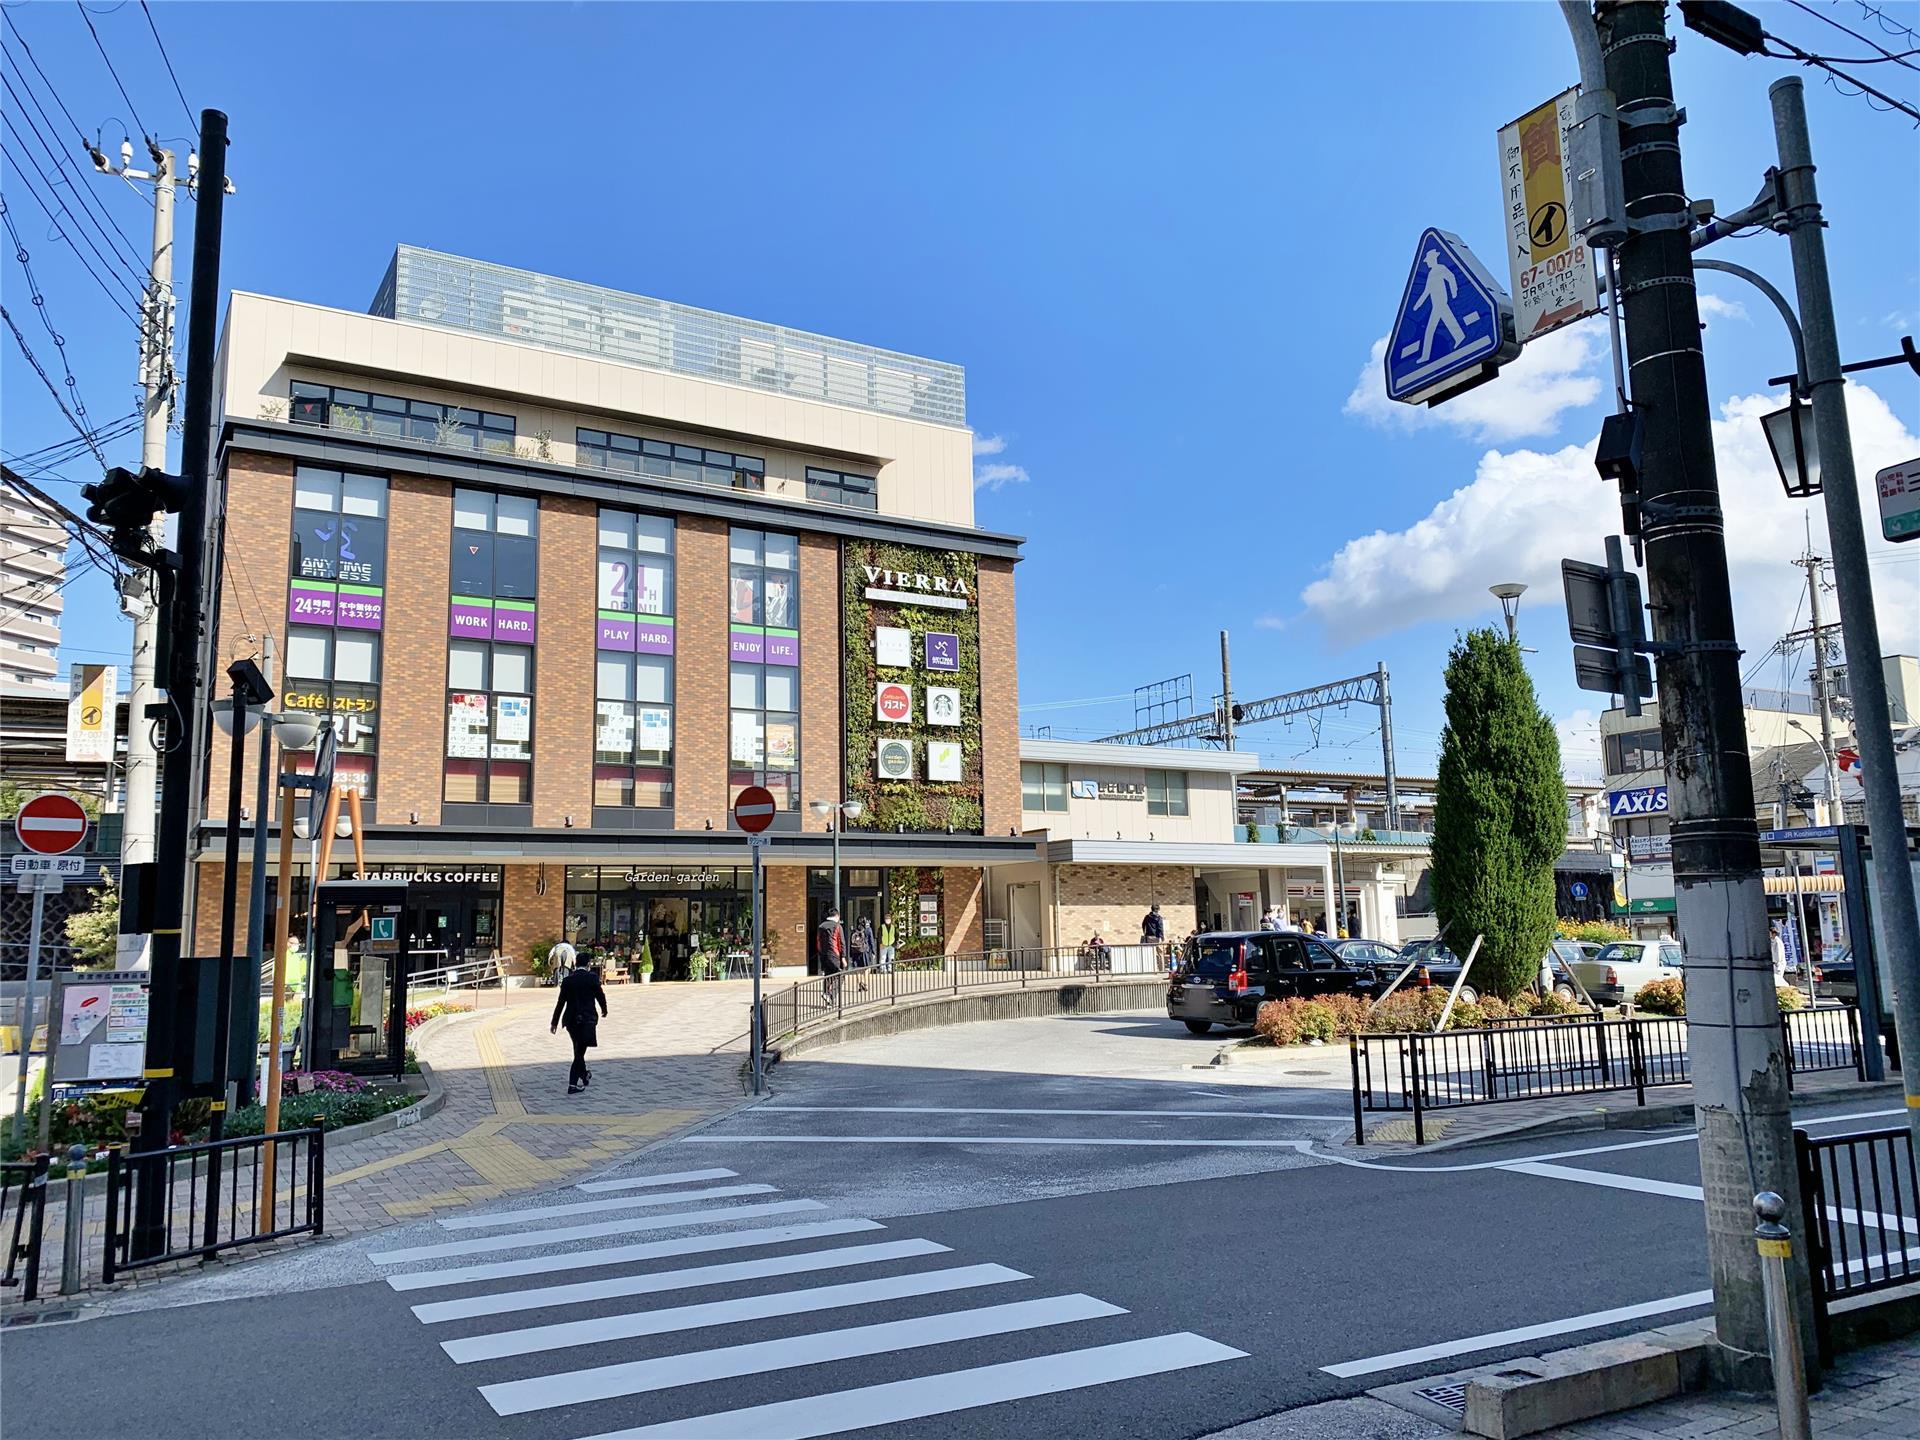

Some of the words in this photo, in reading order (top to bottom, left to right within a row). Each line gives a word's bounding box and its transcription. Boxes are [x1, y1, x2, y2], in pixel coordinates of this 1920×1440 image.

[1520, 245, 1585, 289] 67-0078
[862, 565, 970, 594] VIERRA
[454, 614, 488, 628] WORK
[498, 619, 531, 632] HARD.
[603, 629, 630, 641] PLAY
[640, 632, 671, 645] HARD.
[733, 642, 761, 653] ENJOY
[771, 645, 794, 656] LIFE.
[284, 692, 325, 709] Café
[884, 700, 906, 710] ガスト
[15, 859, 81, 871] 自動車・原付
[352, 871, 442, 883] STARBUCKS
[444, 872, 499, 883] COFFEE
[624, 871, 720, 885] Garden-garden
[896, 883, 906, 949] VIERRA
